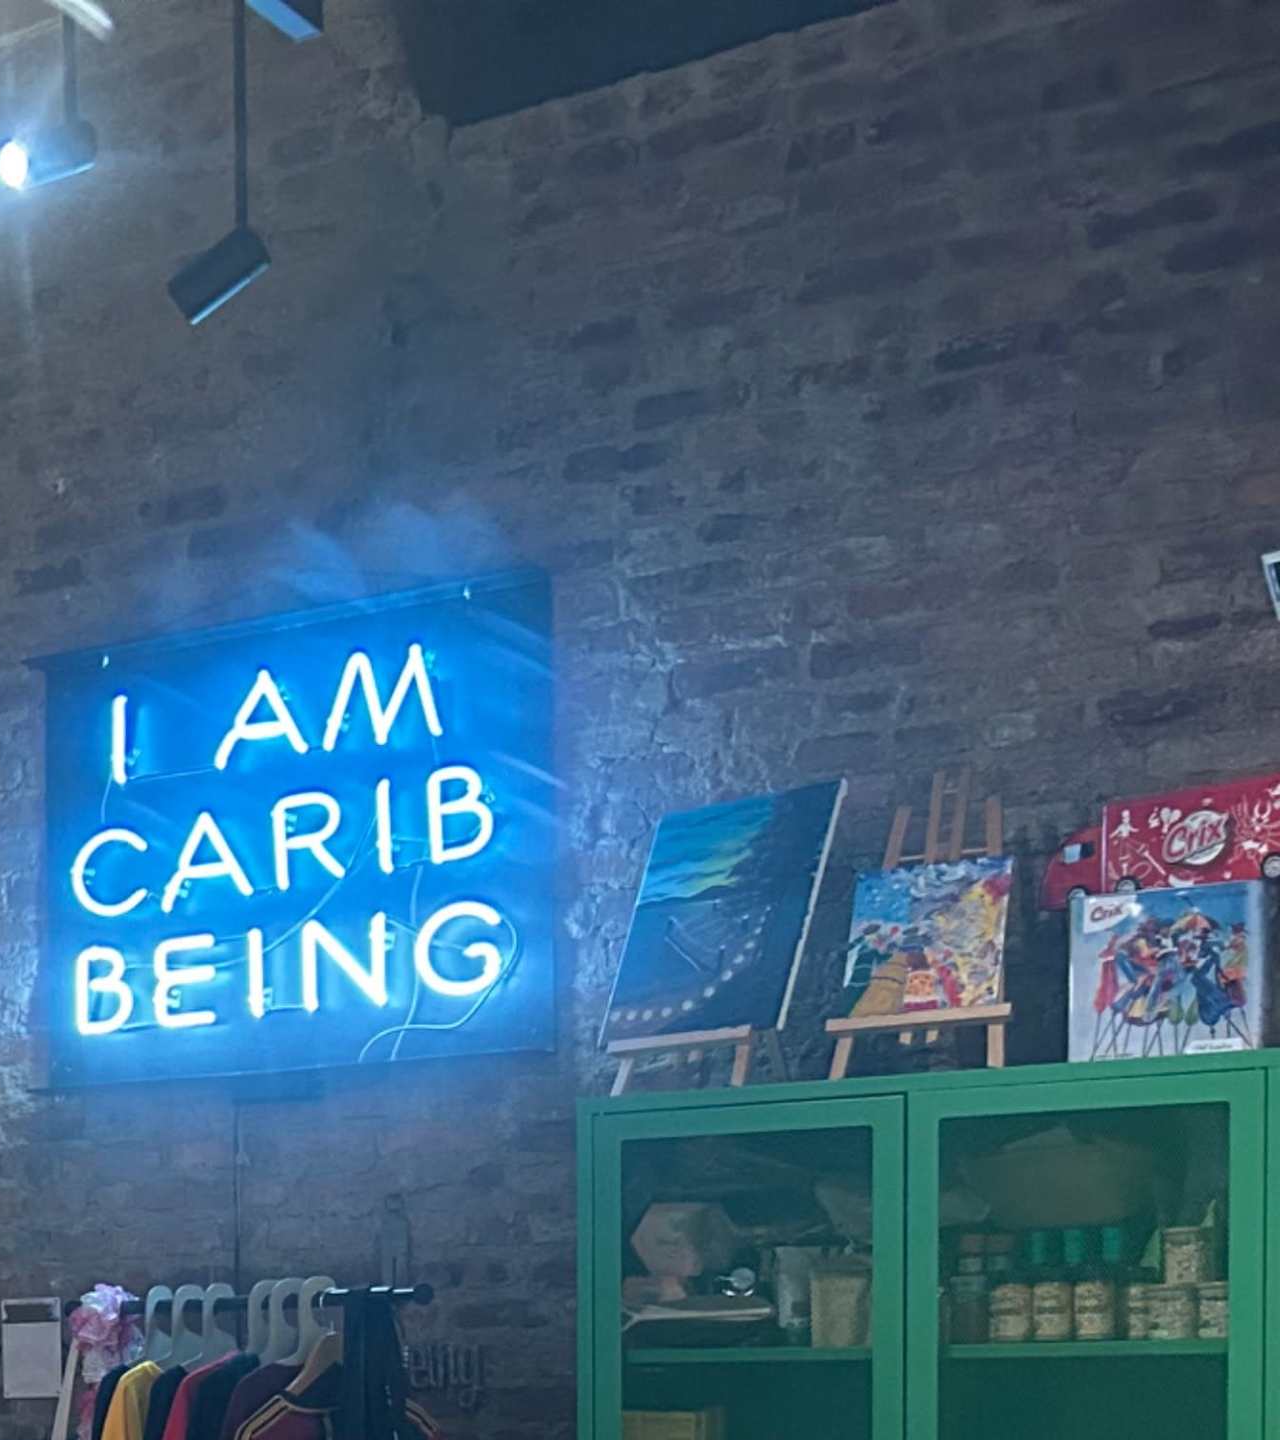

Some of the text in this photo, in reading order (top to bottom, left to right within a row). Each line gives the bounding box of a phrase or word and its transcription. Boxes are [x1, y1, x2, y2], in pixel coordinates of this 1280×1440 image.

[111, 642, 444, 785] I AM
[69, 765, 495, 917] CARIB
[1161, 811, 1230, 865] Crix
[75, 900, 504, 1037] BEING
